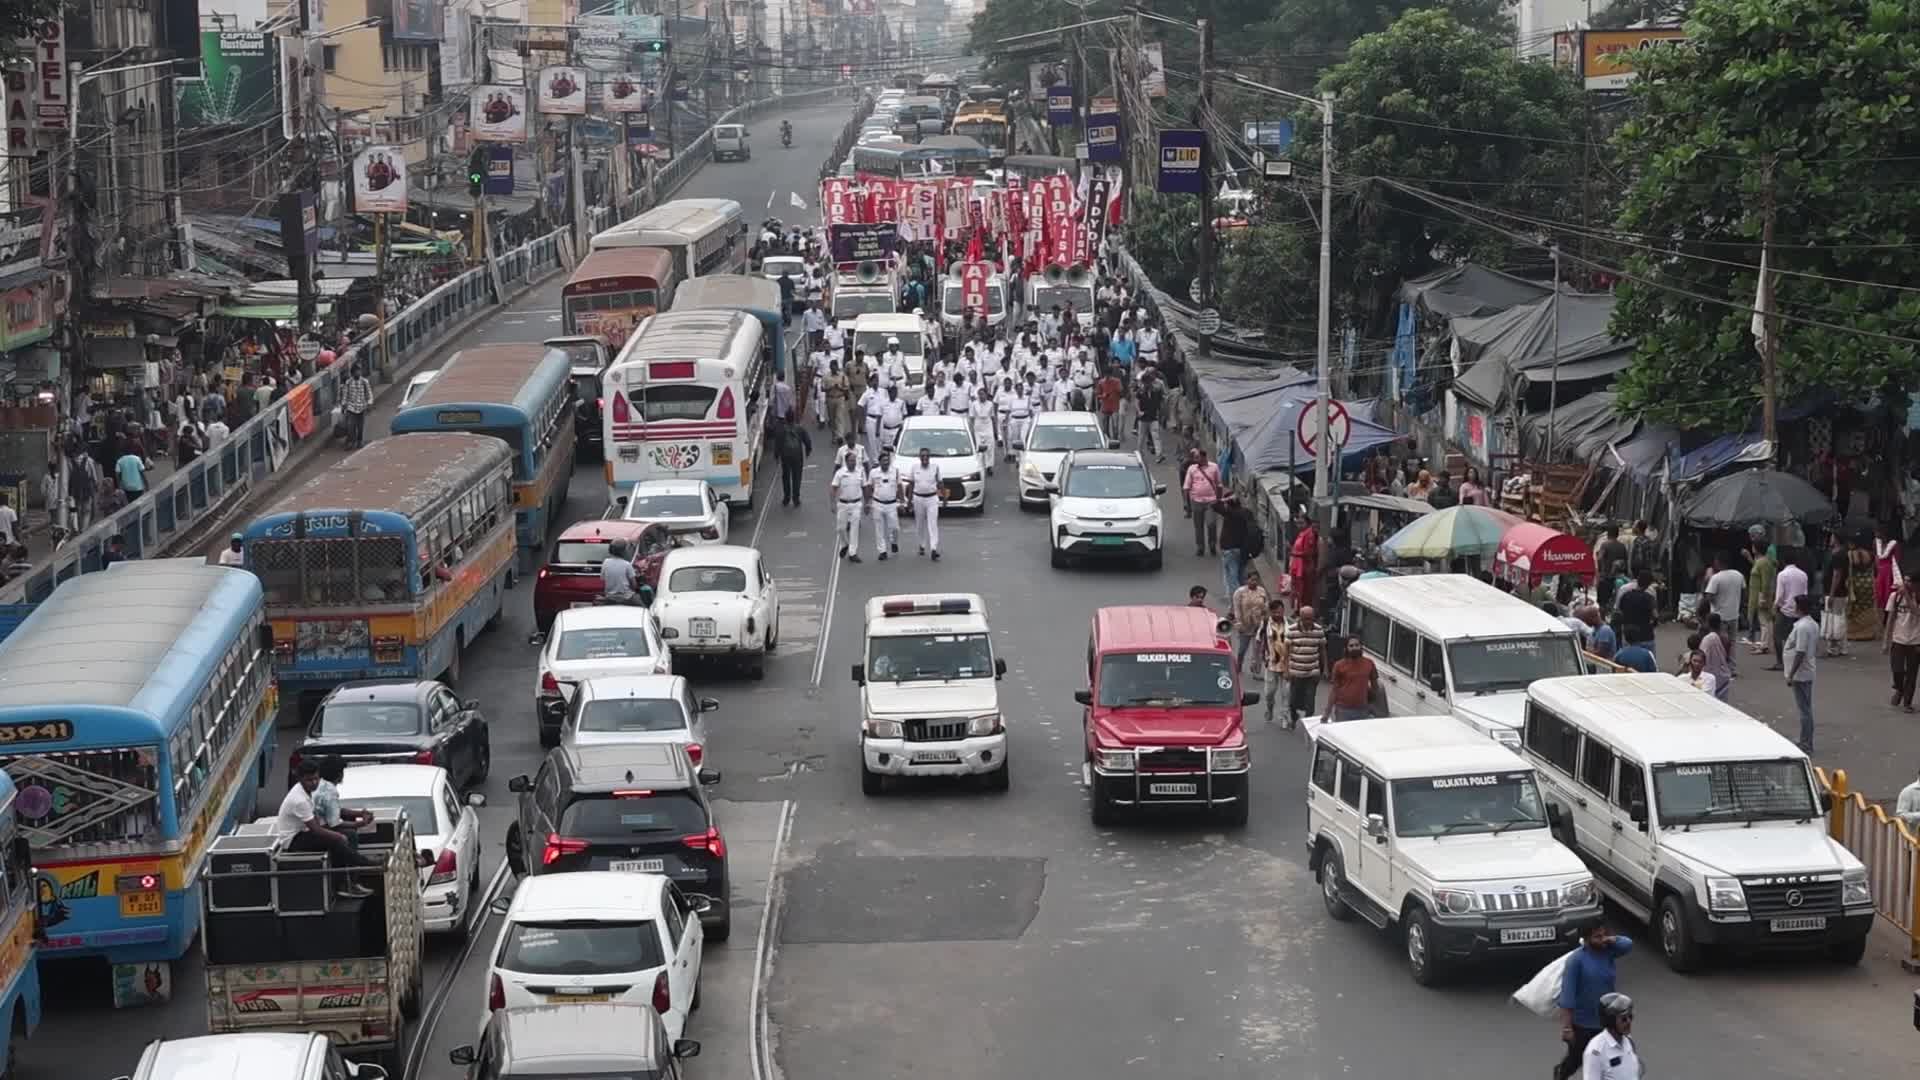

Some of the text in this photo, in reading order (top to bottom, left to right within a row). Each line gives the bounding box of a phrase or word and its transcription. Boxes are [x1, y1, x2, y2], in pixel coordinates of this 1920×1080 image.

[9, 72, 26, 148] BAR
[1179, 149, 1197, 161] LIC
[1056, 218, 1069, 262] AISA
[1076, 223, 1086, 257] AISA
[1543, 549, 1587, 561] Havmor
[1517, 641, 1540, 649] POLICE
[1137, 654, 1192, 662] KOLKATA POLICE
[1676, 766, 1712, 776] KOLKATA
[1432, 775, 1498, 789] KOLKATA POLICE
[1765, 875, 1820, 885] FORCE
